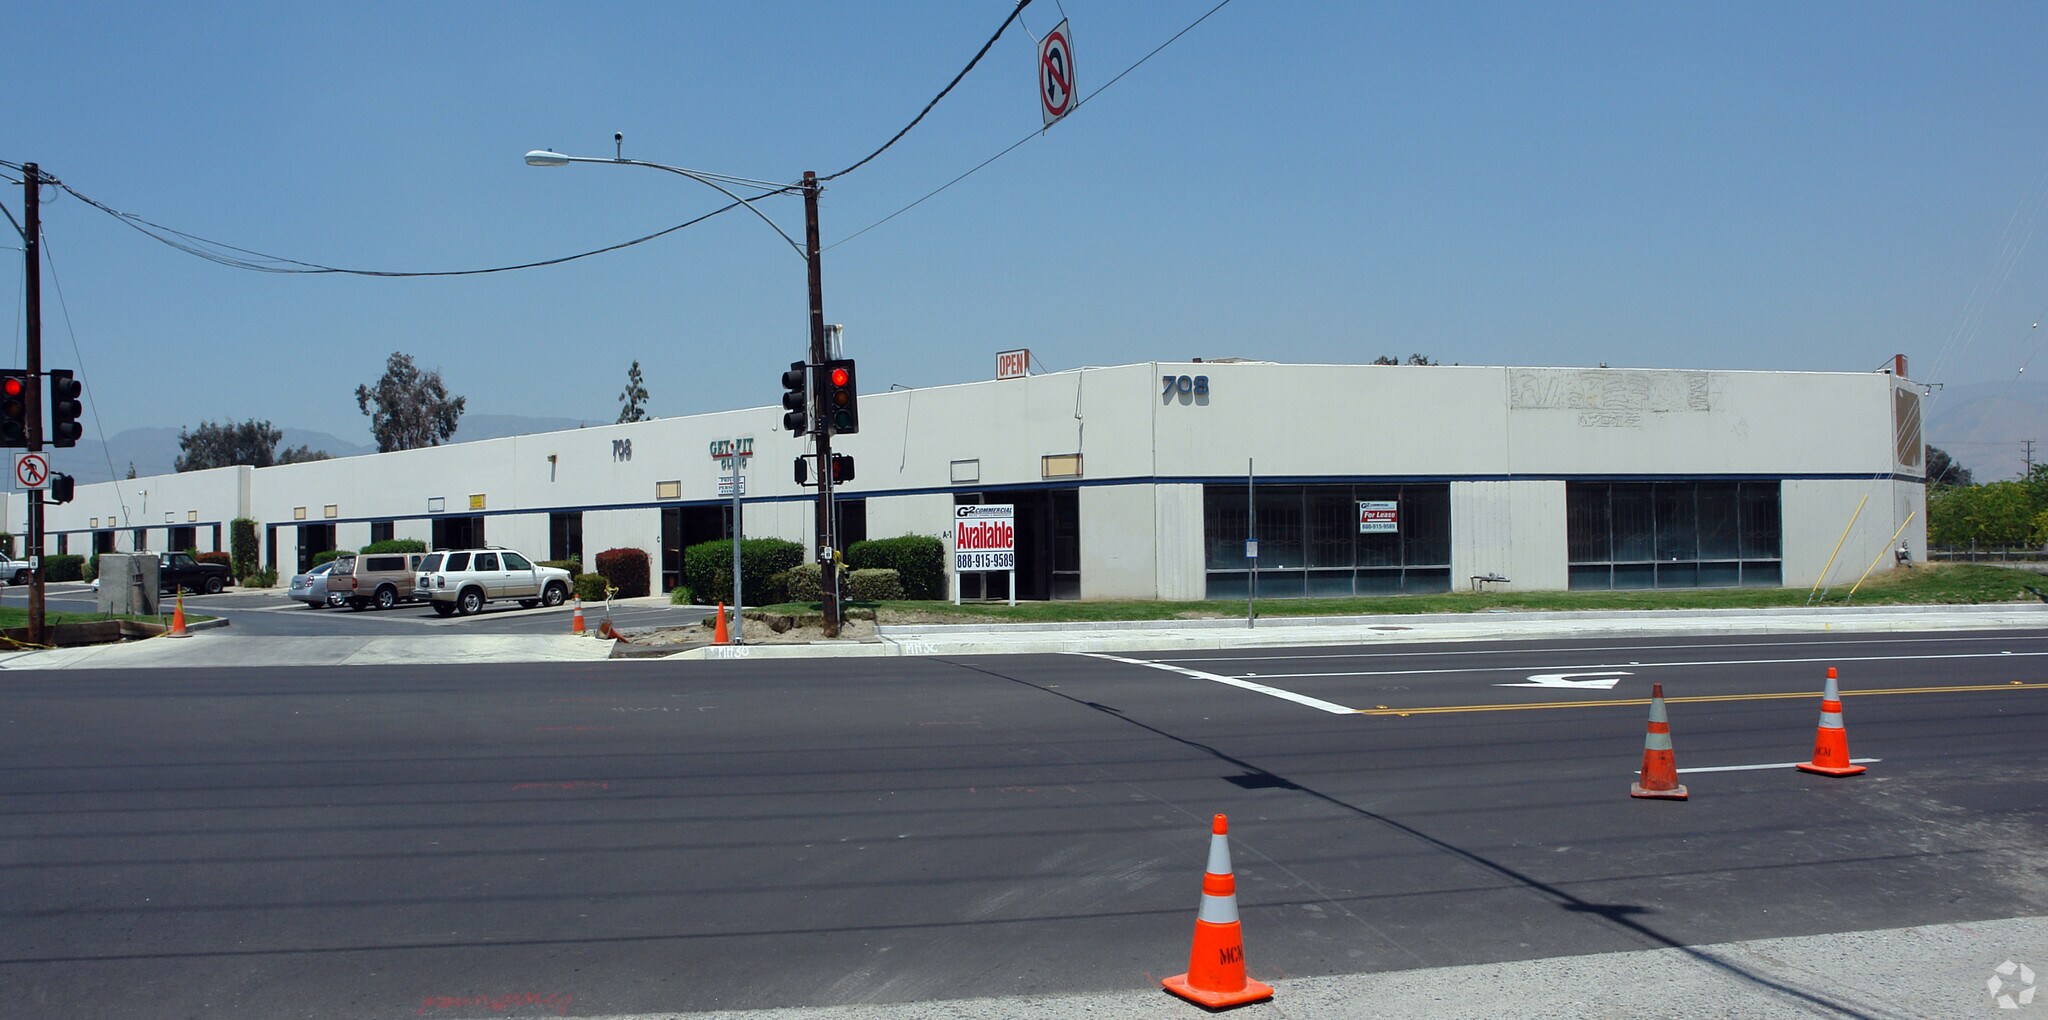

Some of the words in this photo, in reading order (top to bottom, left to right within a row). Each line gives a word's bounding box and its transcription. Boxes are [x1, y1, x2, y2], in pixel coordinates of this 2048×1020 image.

[1000, 353, 1023, 376] OPEN
[1162, 375, 1210, 397] 708
[612, 438, 632, 458] 708
[710, 440, 730, 455] GET
[736, 438, 754, 453] FIT
[943, 530, 952, 539] A-1
[957, 521, 1013, 549] Available
[957, 553, 1014, 568] 888-915-9589
